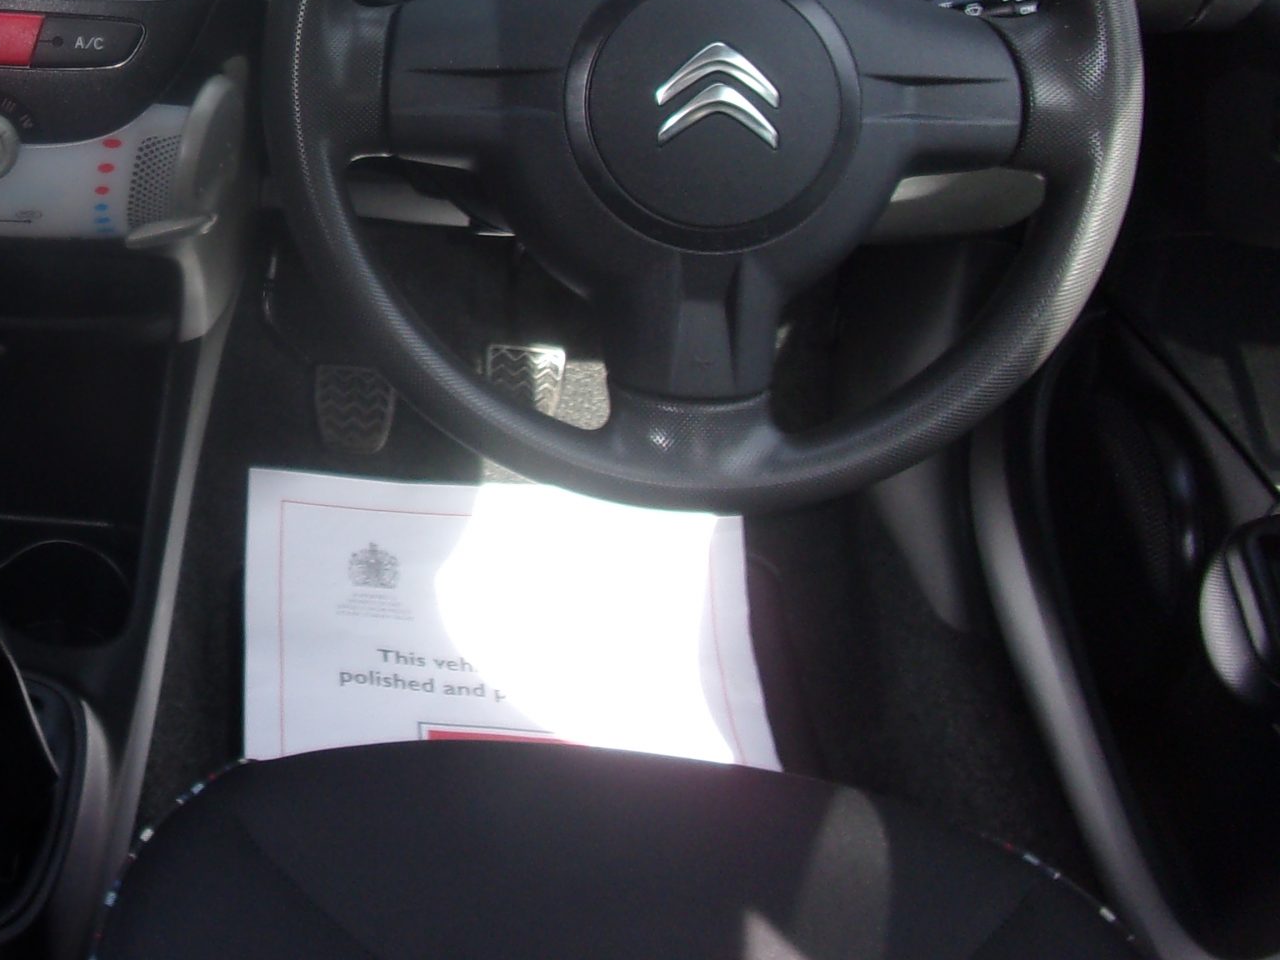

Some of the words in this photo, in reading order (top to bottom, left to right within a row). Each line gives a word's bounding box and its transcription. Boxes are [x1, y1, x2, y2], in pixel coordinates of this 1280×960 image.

[74, 36, 104, 50] A/C
[376, 648, 426, 667] This
[339, 670, 435, 694] polished
[443, 683, 486, 698] and
